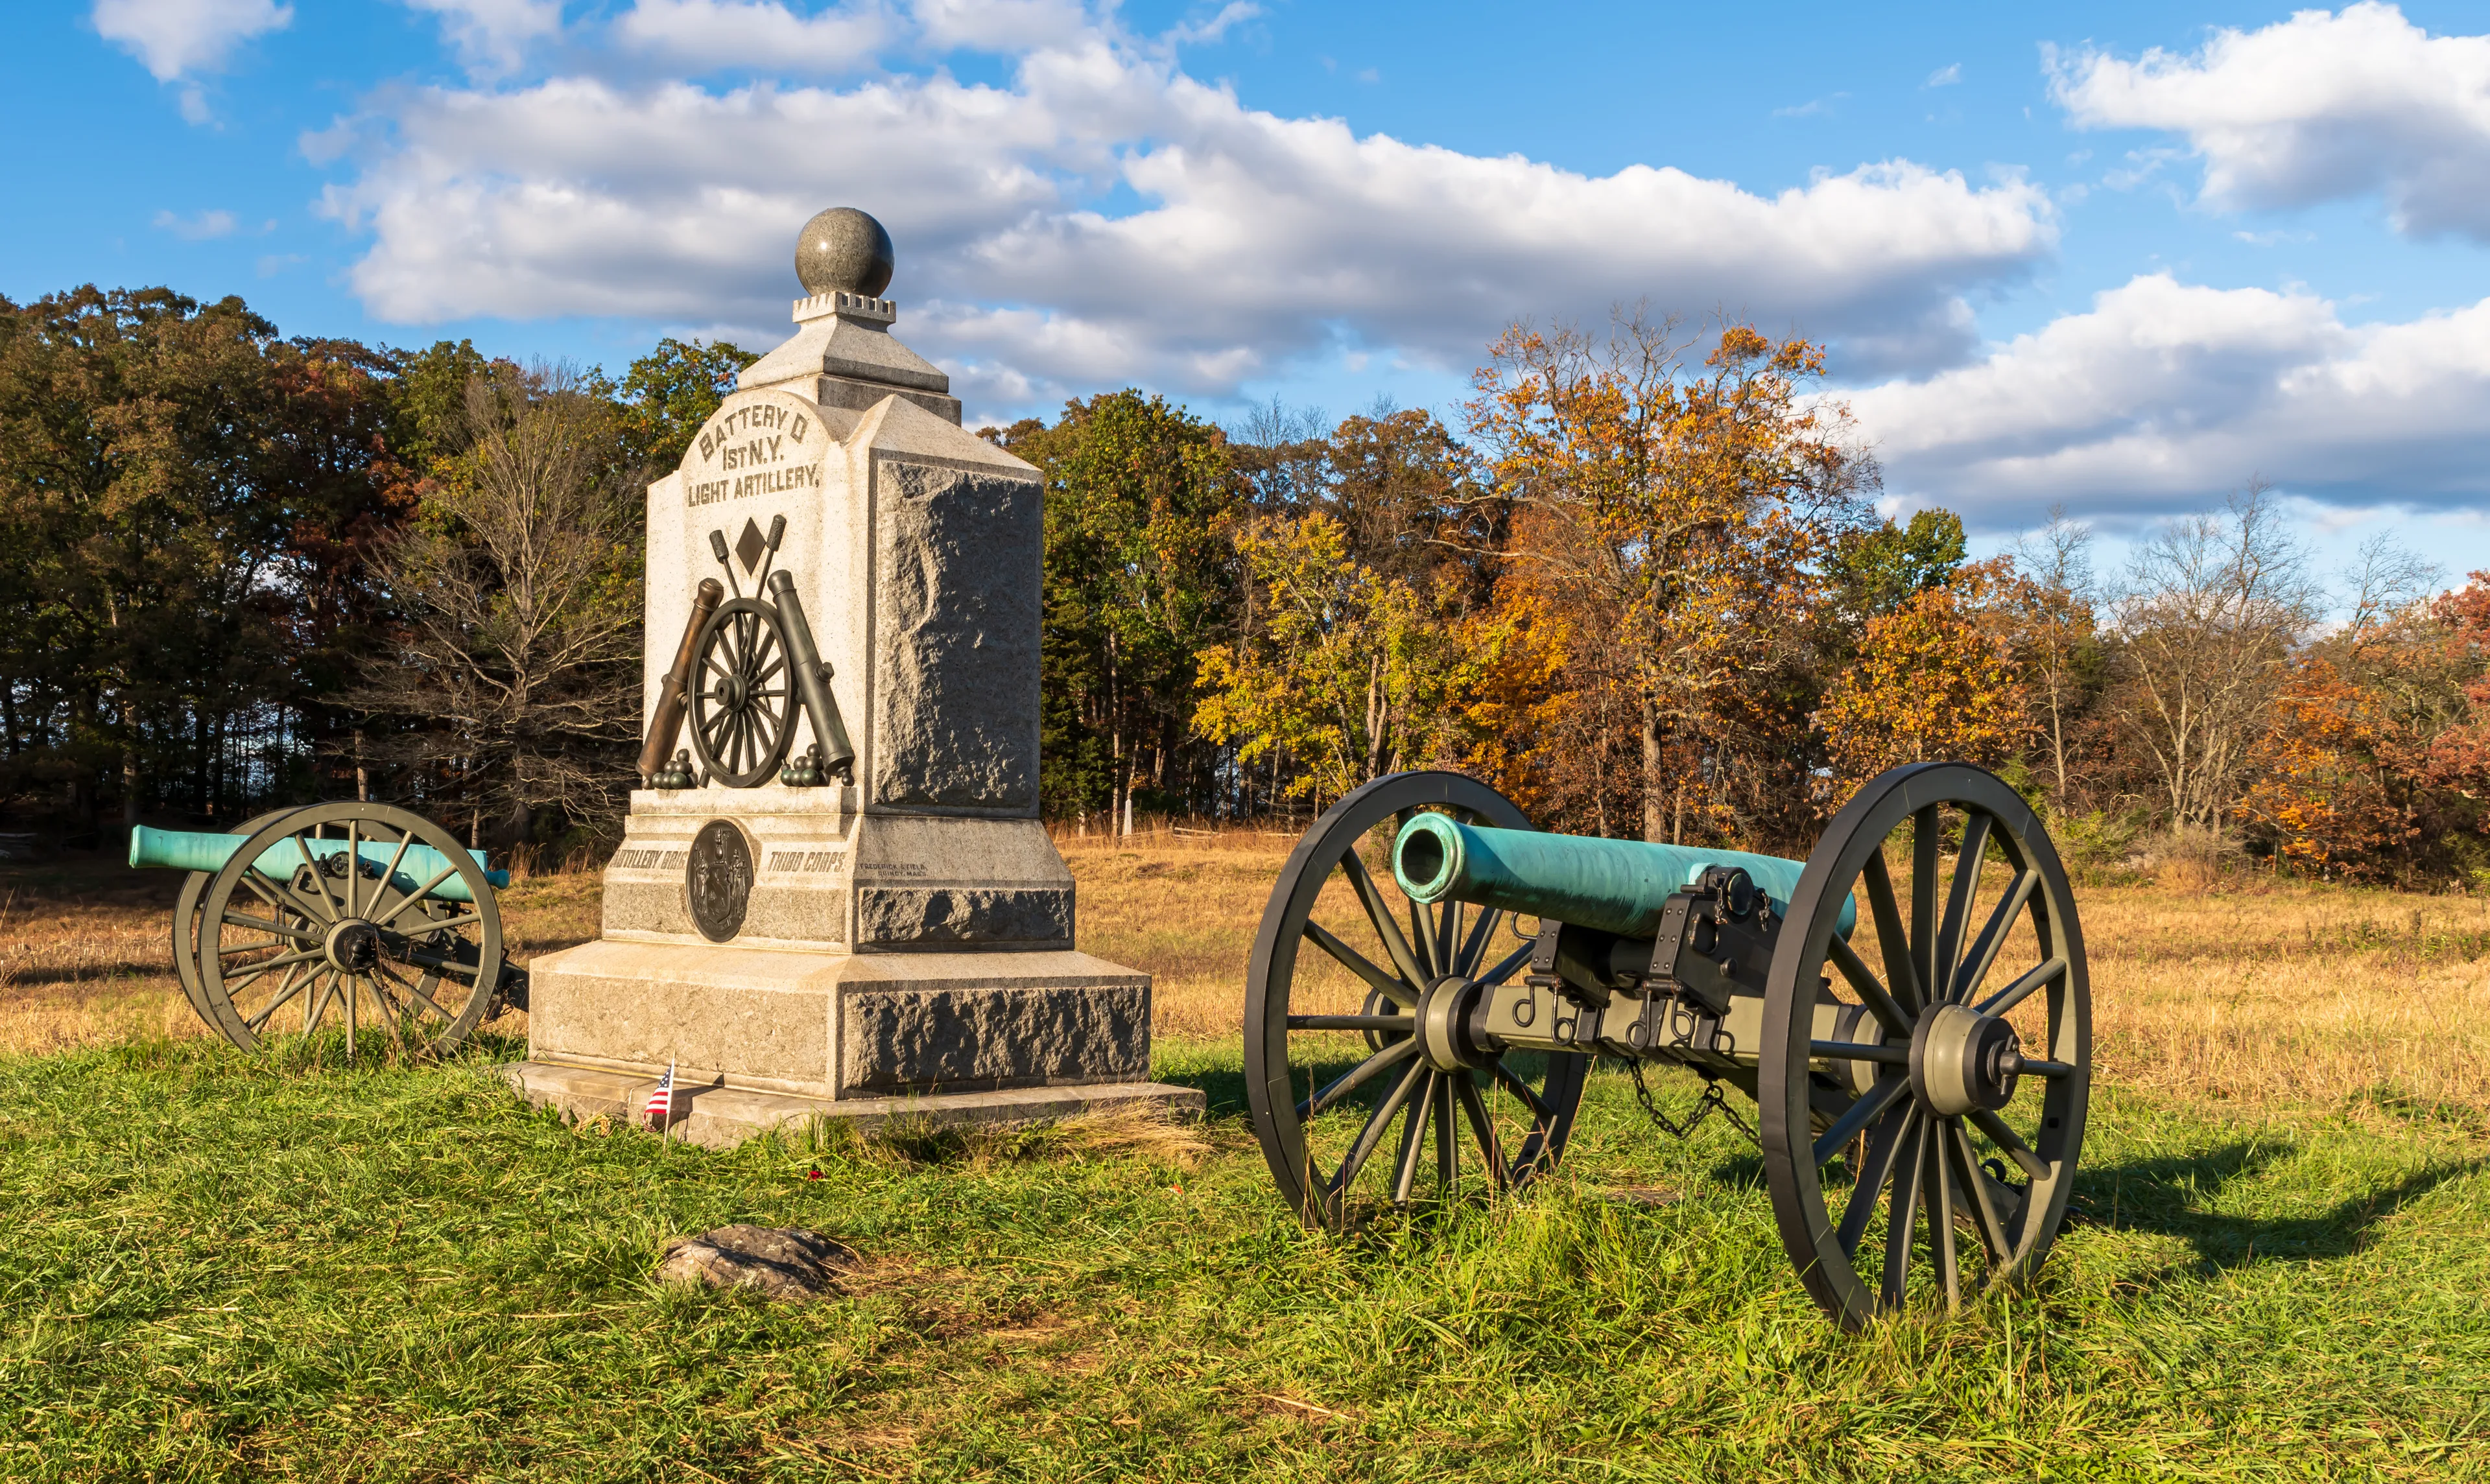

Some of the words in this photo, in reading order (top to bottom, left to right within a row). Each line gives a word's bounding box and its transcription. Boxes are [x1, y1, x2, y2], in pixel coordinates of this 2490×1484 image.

[698, 405, 788, 463] BATTERY
[790, 413, 810, 444] D
[749, 434, 784, 466] N.Y.
[688, 479, 729, 507] LIGHT
[610, 849, 664, 869] ARTILLERY
[768, 851, 804, 872] THIRD
